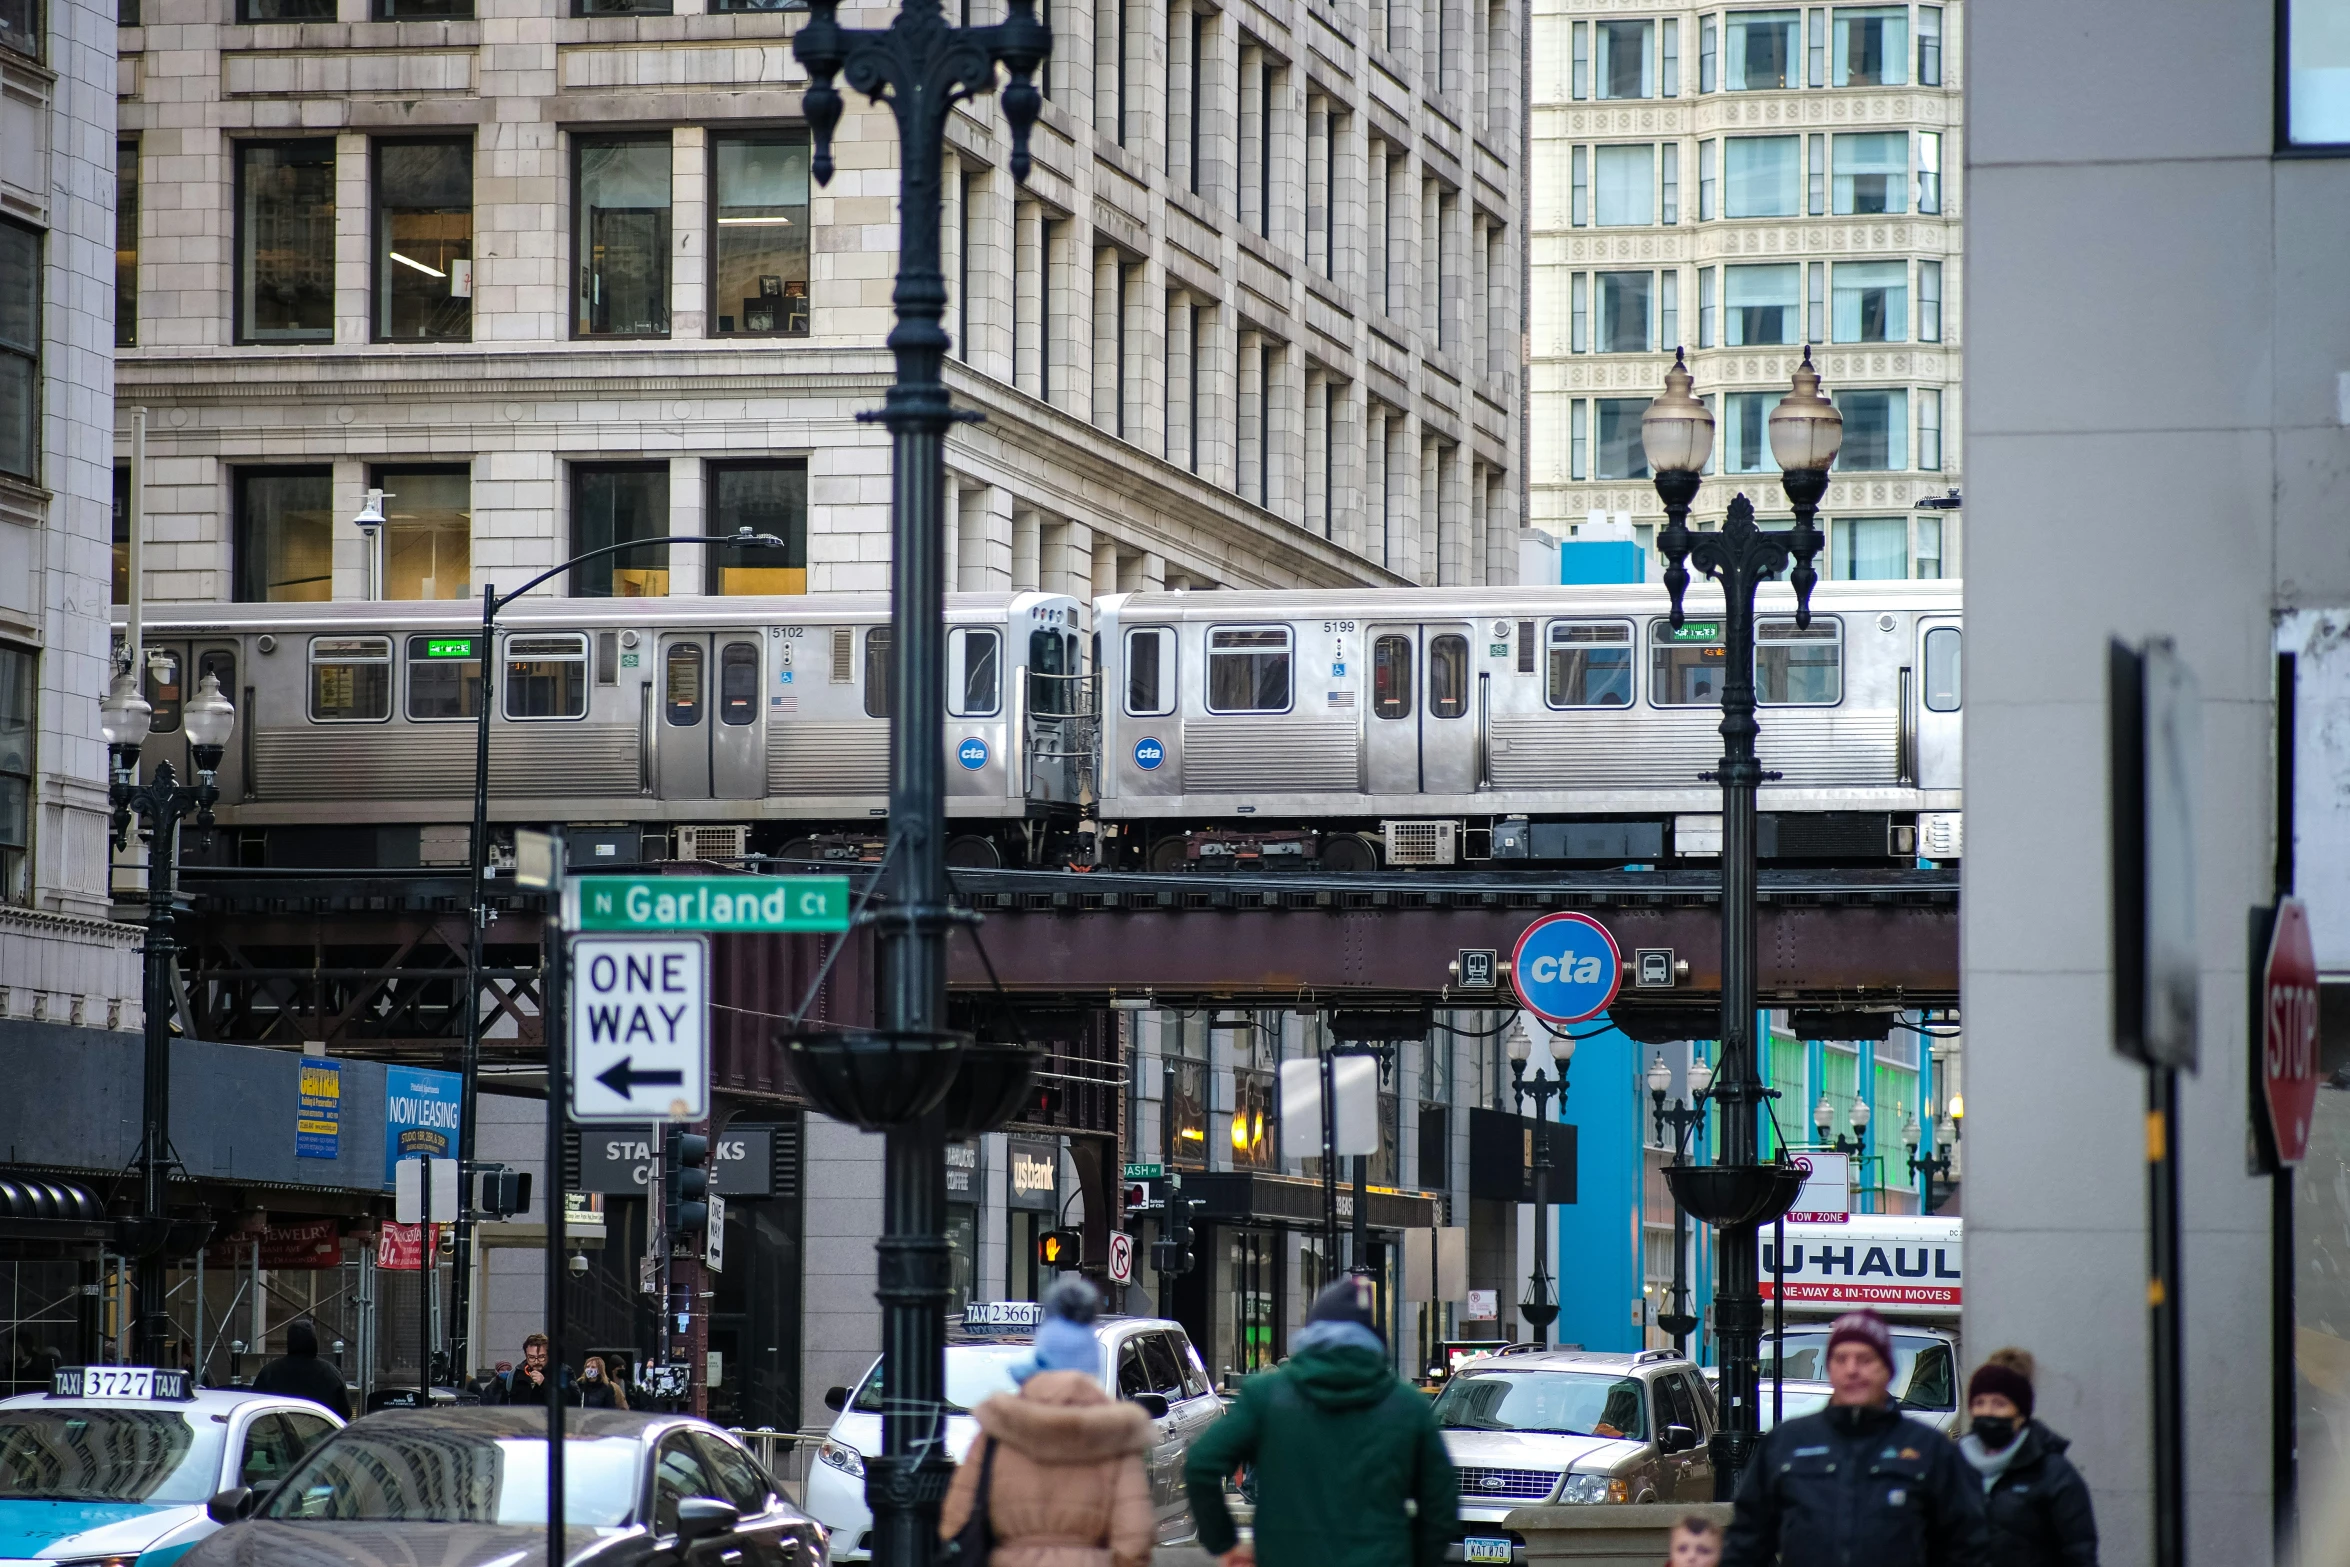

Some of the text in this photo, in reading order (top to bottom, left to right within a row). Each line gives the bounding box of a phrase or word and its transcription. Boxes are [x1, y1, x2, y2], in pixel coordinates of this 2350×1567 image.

[772, 626, 804, 639] 5102
[1323, 621, 1355, 634] 5199
[961, 745, 985, 760] cta
[1137, 745, 1161, 760] cta
[594, 884, 827, 924] N Garland Ct
[590, 953, 687, 993] ONE
[1531, 949, 1603, 984] cta
[588, 1004, 687, 1044] WAY
[2268, 984, 2317, 1080] STOP
[301, 1066, 340, 1098] CENTRAL
[389, 1095, 458, 1130] NOW LEASING
[606, 1141, 746, 1161] STAKS
[946, 1170, 969, 1191] COFFEE
[711, 1201, 722, 1220] ONE
[1790, 1212, 1844, 1223] TOW ZONE
[710, 1221, 721, 1238] WAY
[1949, 1229, 1959, 1237] DC
[1771, 1286, 1951, 1300] NE-WAY & IN-TOWN MOVES
[966, 1304, 1046, 1324] TAXI 2366 TA
[55, 1372, 181, 1398] TAXI 3727 TAXI
[1471, 1545, 1504, 1557] KAT 079
